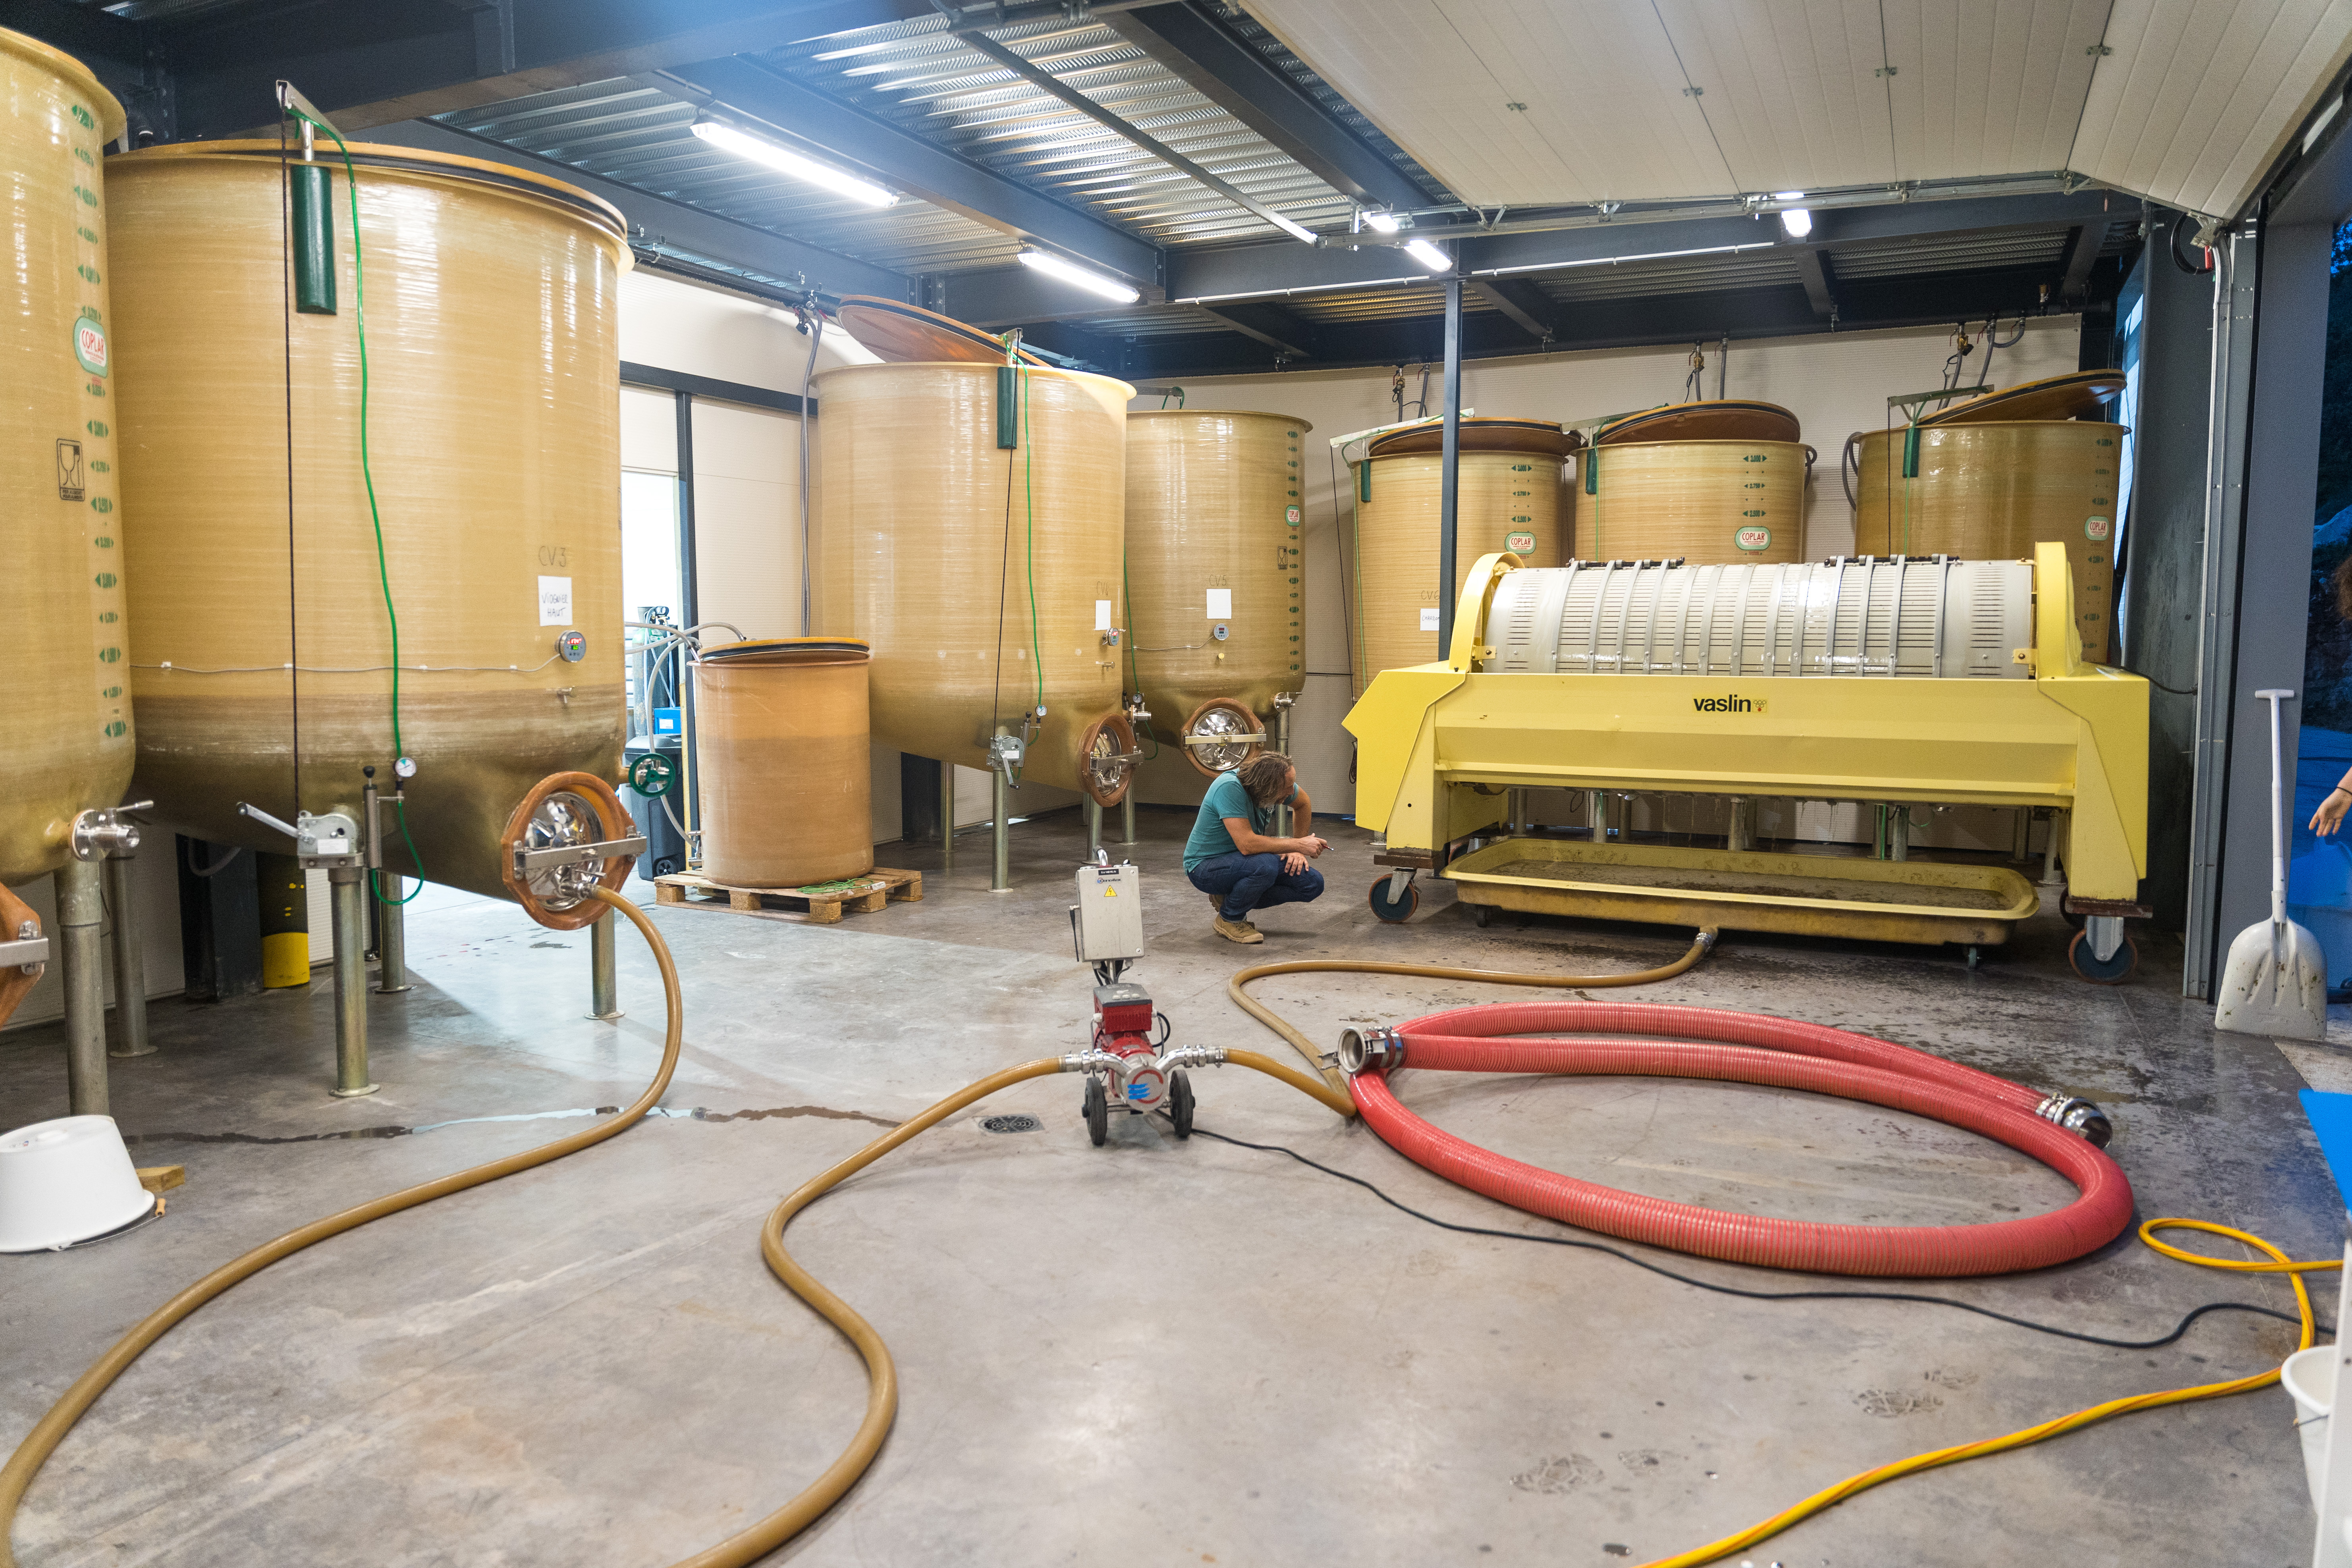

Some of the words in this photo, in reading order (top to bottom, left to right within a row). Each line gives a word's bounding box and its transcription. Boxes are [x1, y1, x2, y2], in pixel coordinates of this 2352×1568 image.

[82, 330, 104, 356] COPLAR
[1288, 510, 1299, 519] COPLAR
[2090, 522, 2106, 531] COPLAR
[538, 546, 567, 567] CV3
[1209, 574, 1227, 586] CV5
[1096, 581, 1109, 597] CV4
[1421, 590, 1440, 600] CV6
[547, 607, 566, 617] HAUT
[1693, 694, 1751, 712] vaslin
